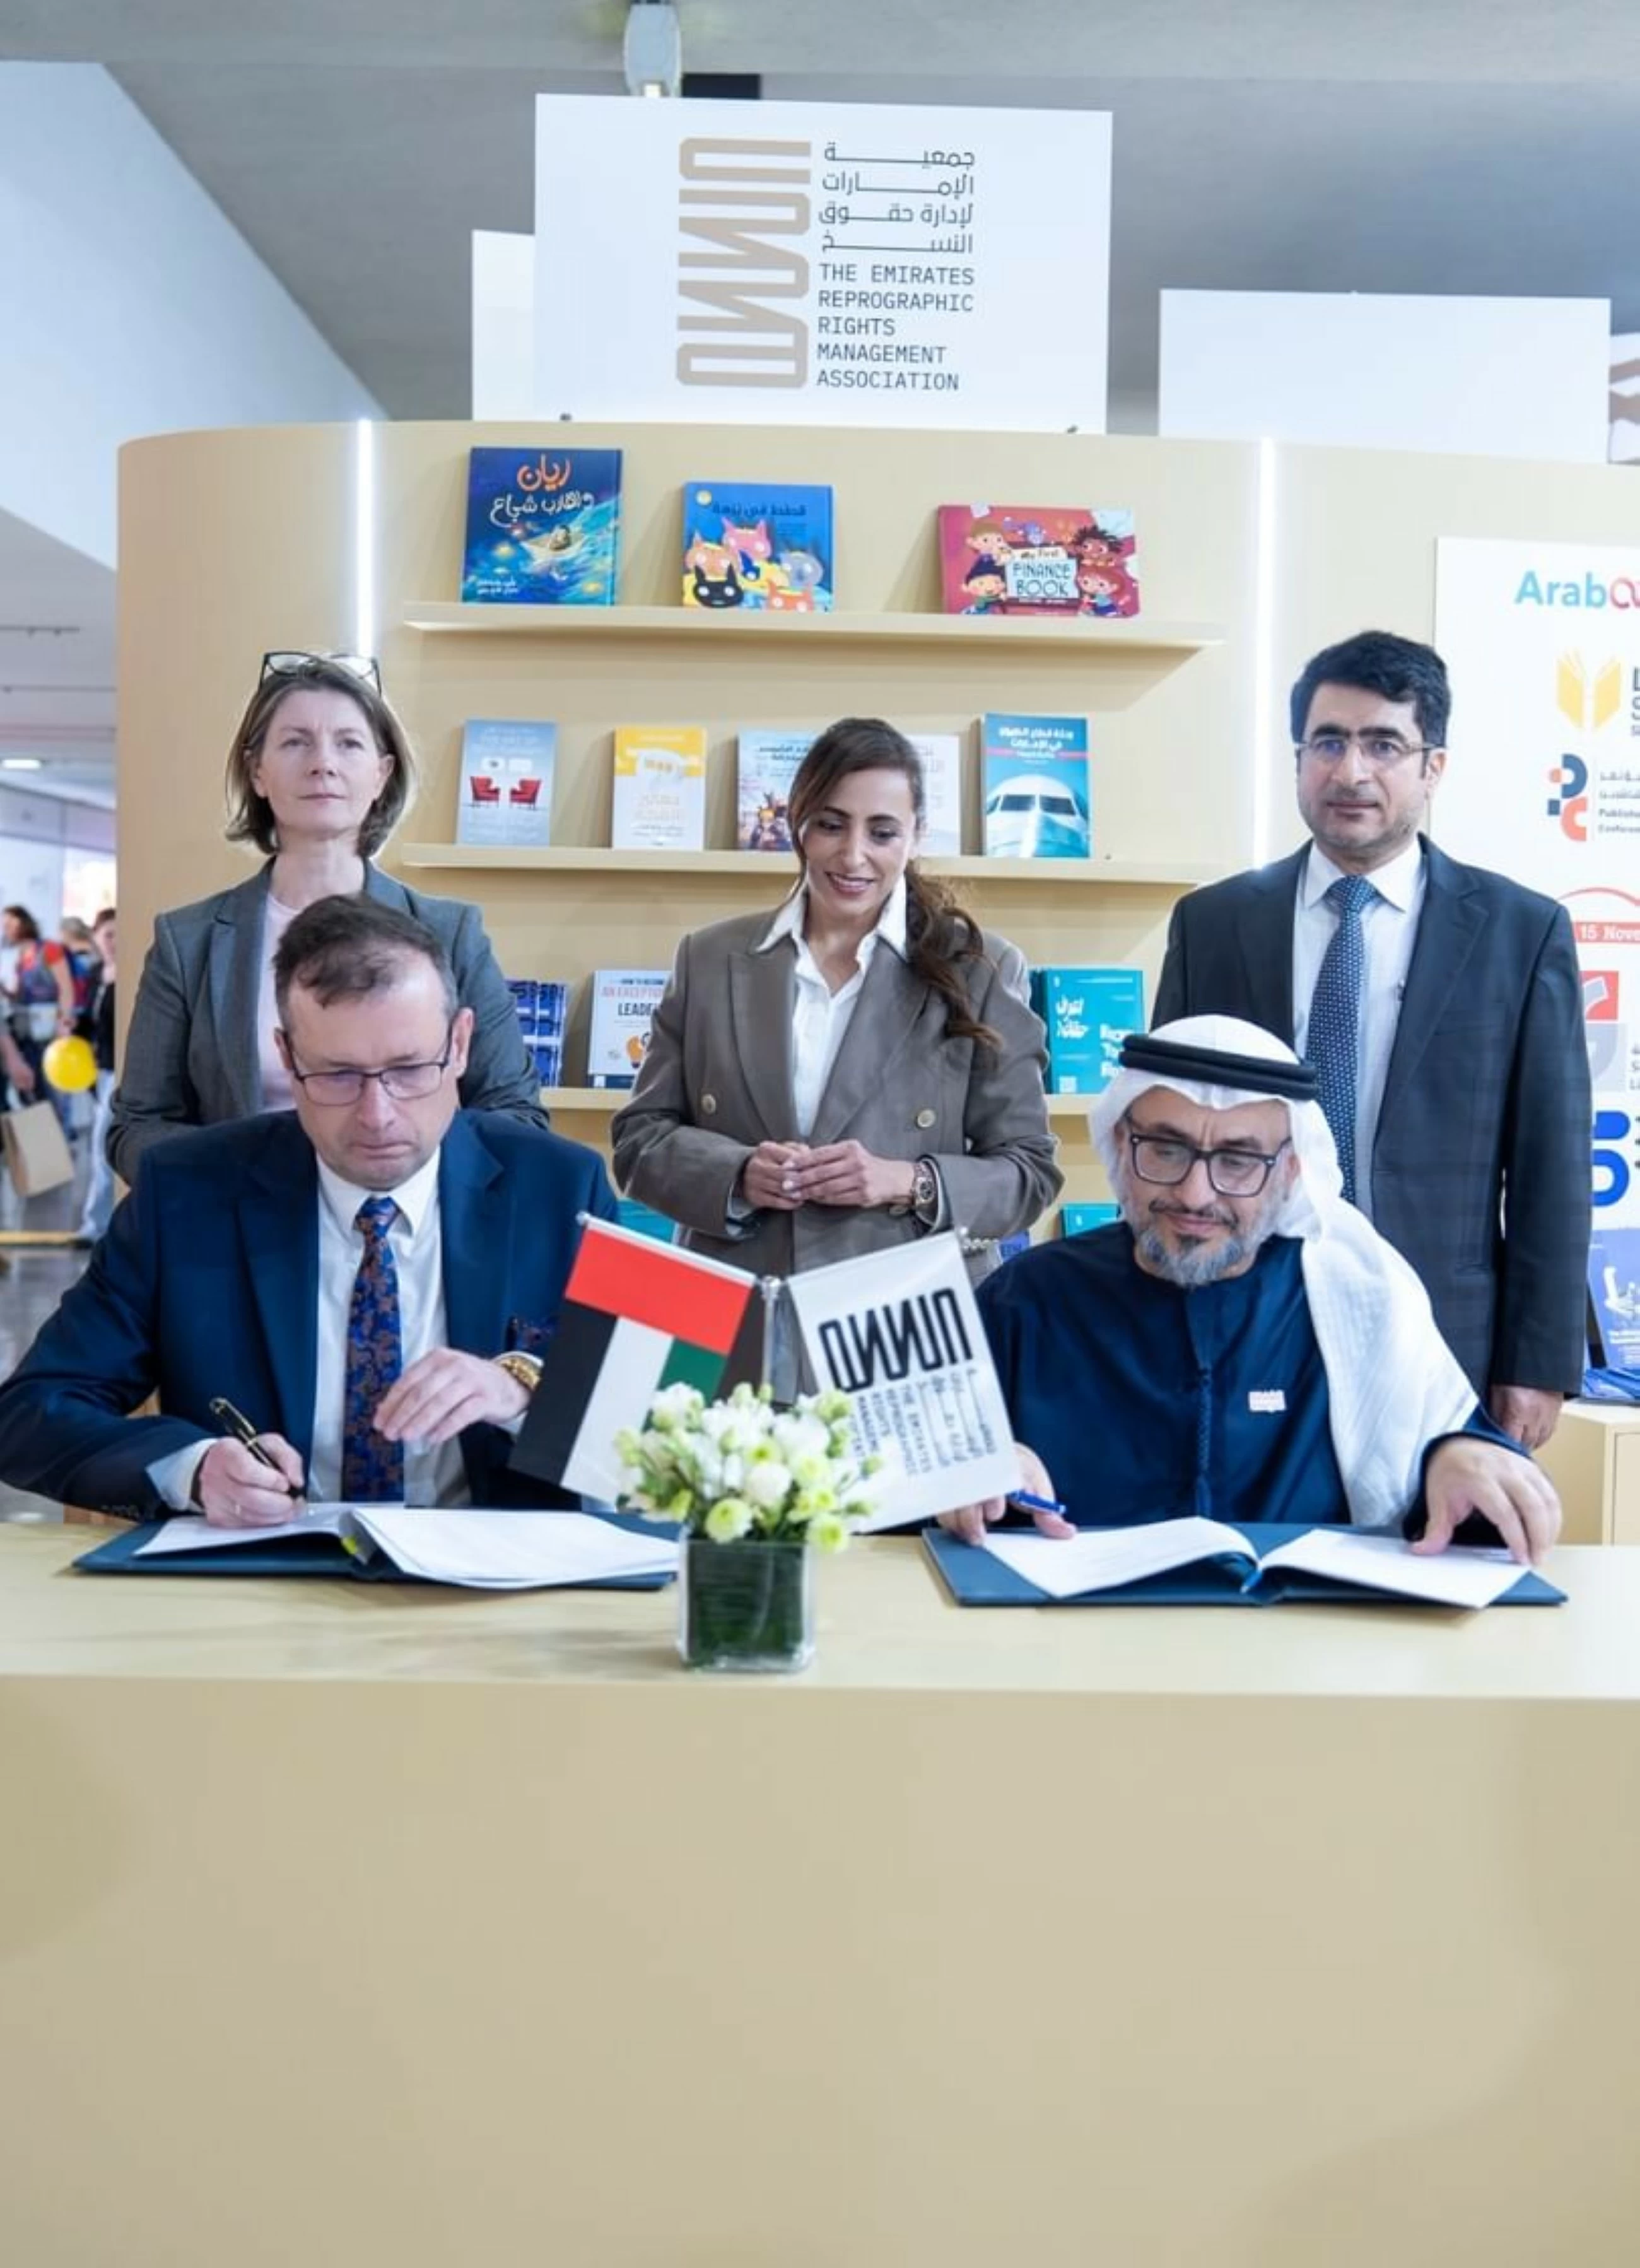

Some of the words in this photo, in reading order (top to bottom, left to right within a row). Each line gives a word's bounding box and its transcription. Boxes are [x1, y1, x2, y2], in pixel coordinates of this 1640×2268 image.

[819, 263, 857, 282] THE
[871, 264, 975, 285] EMIRATES
[819, 290, 974, 312] REPROGRAPHIC
[818, 316, 896, 336] RIGHTS
[817, 343, 947, 363] MANAGEMENT
[816, 369, 959, 391] ASSOCIATION
[1012, 562, 1071, 579] FINANCE
[1016, 579, 1068, 596] BOOK
